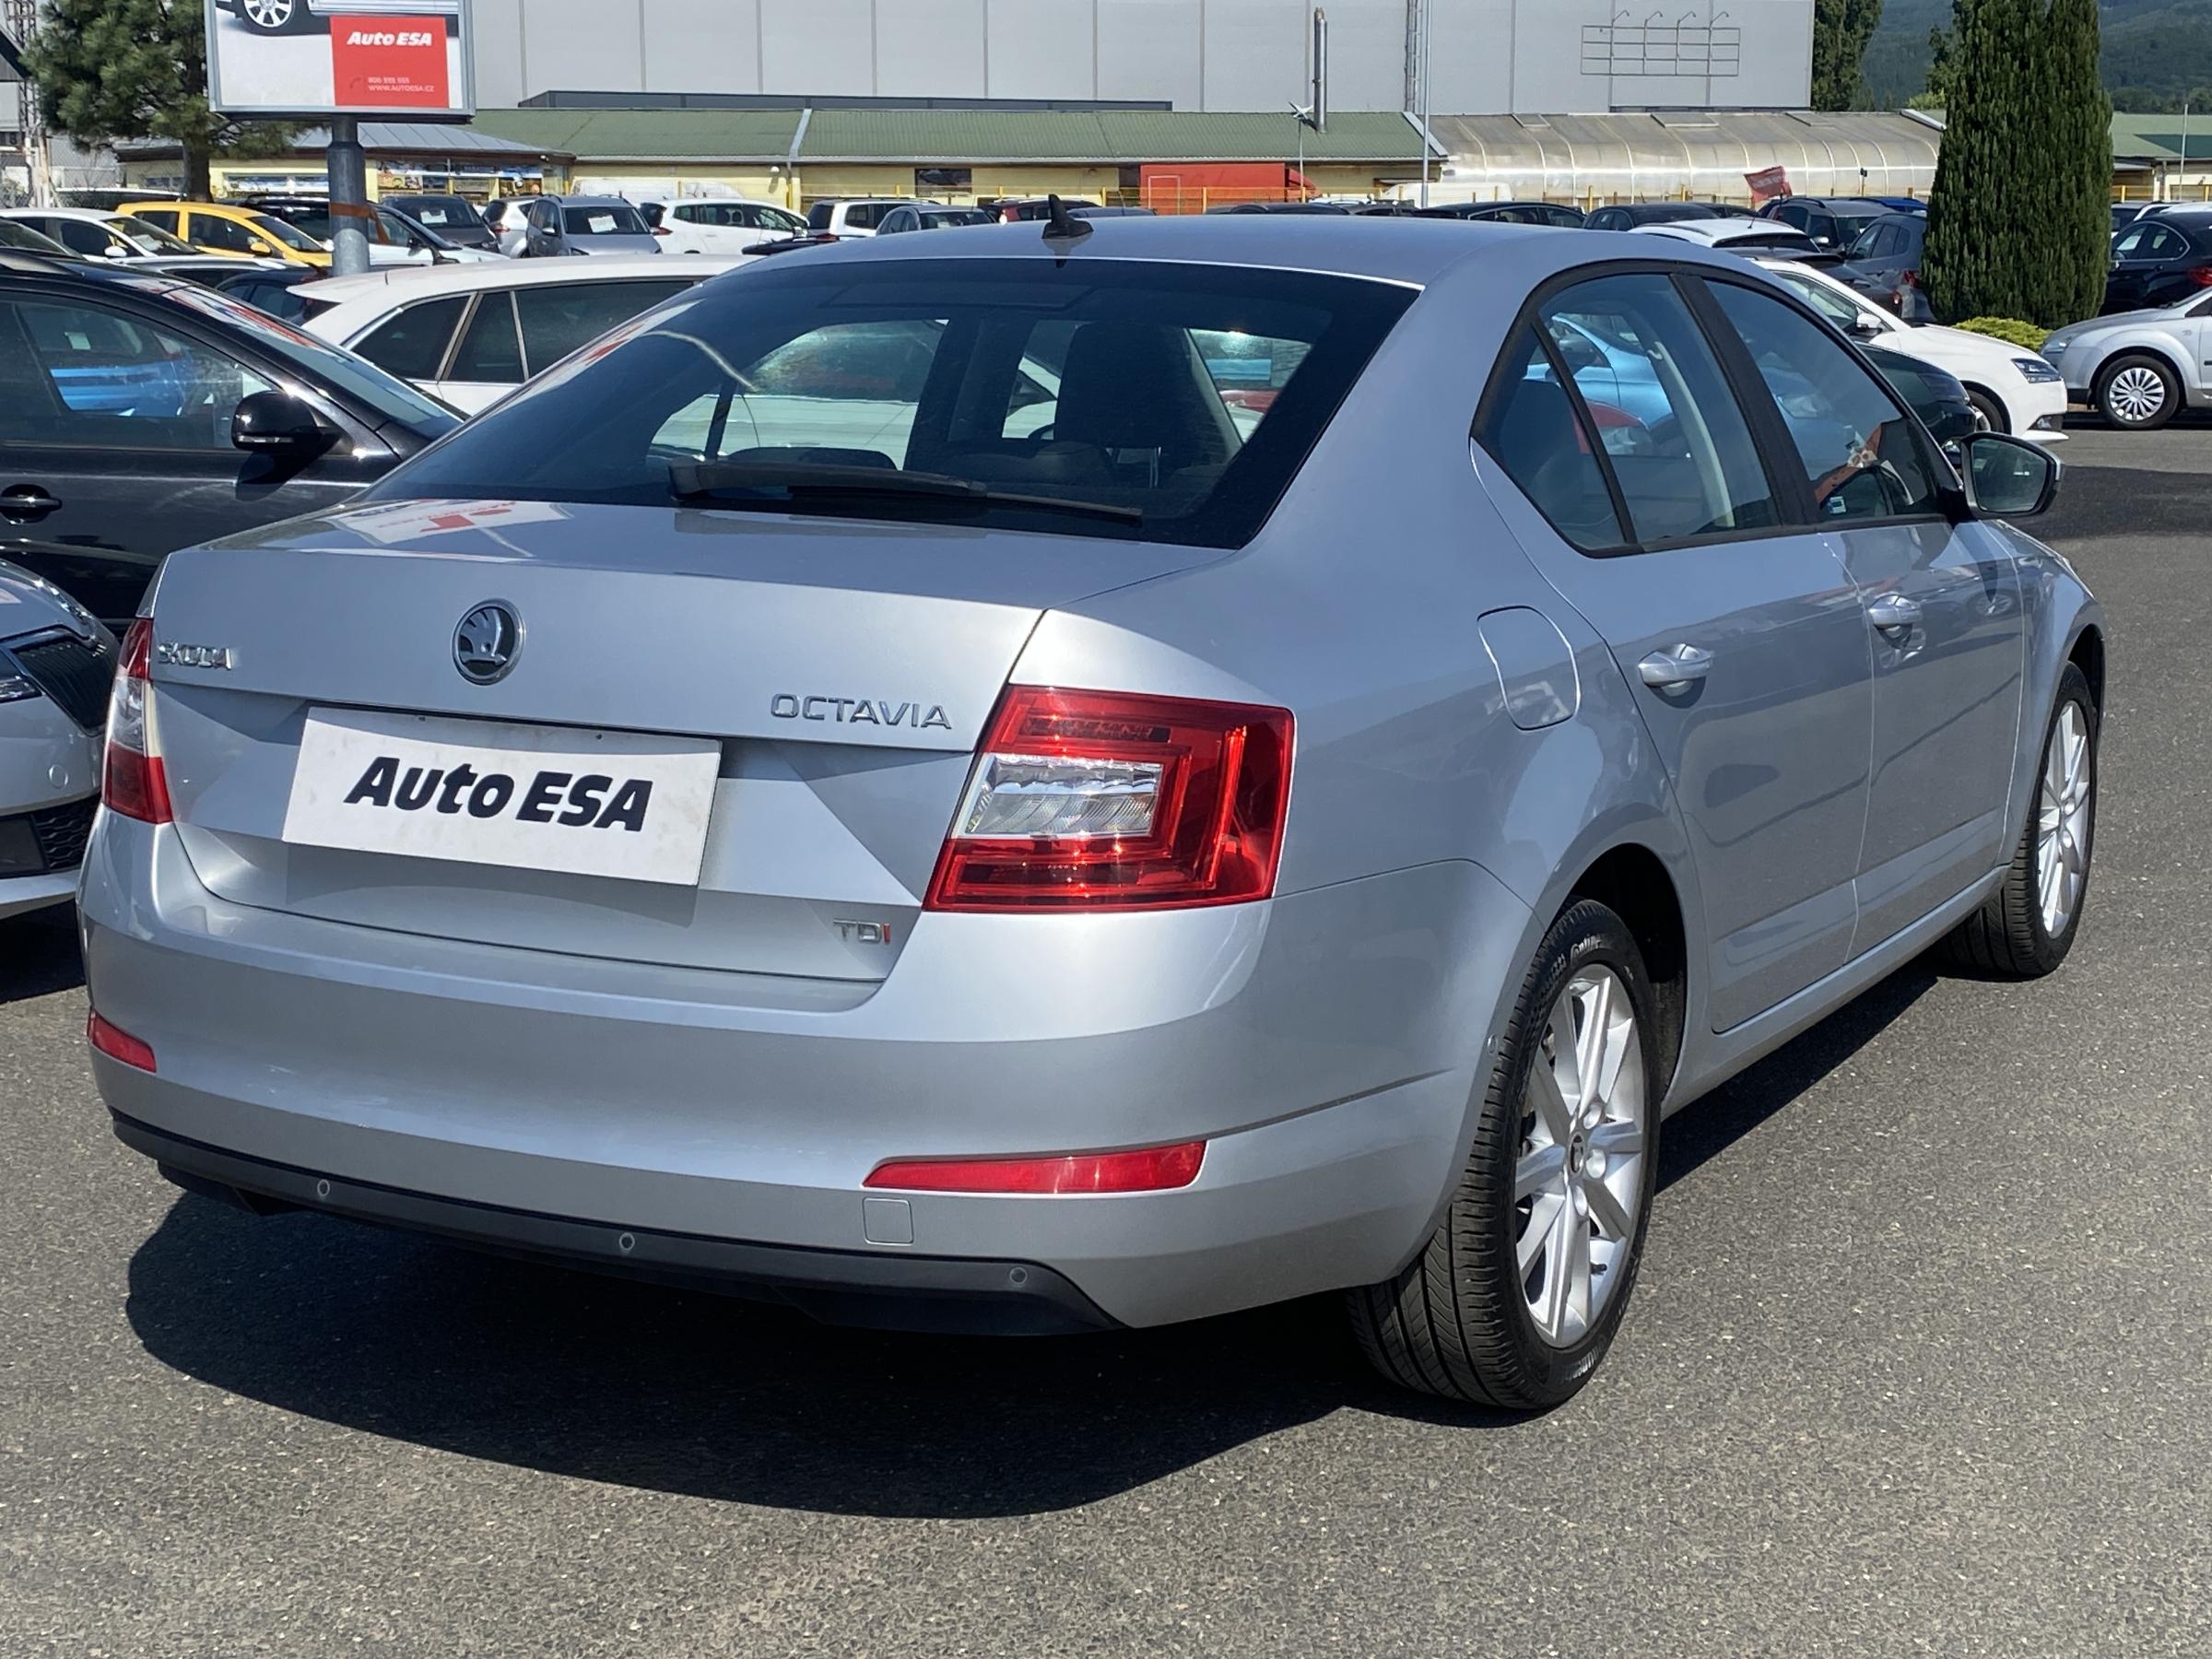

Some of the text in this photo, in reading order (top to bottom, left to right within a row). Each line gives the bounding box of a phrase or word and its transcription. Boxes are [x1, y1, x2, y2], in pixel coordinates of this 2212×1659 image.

[347, 31, 432, 46] Auto ESA
[771, 694, 952, 730] OCTAVIA
[343, 756, 653, 831] Auto ESA
